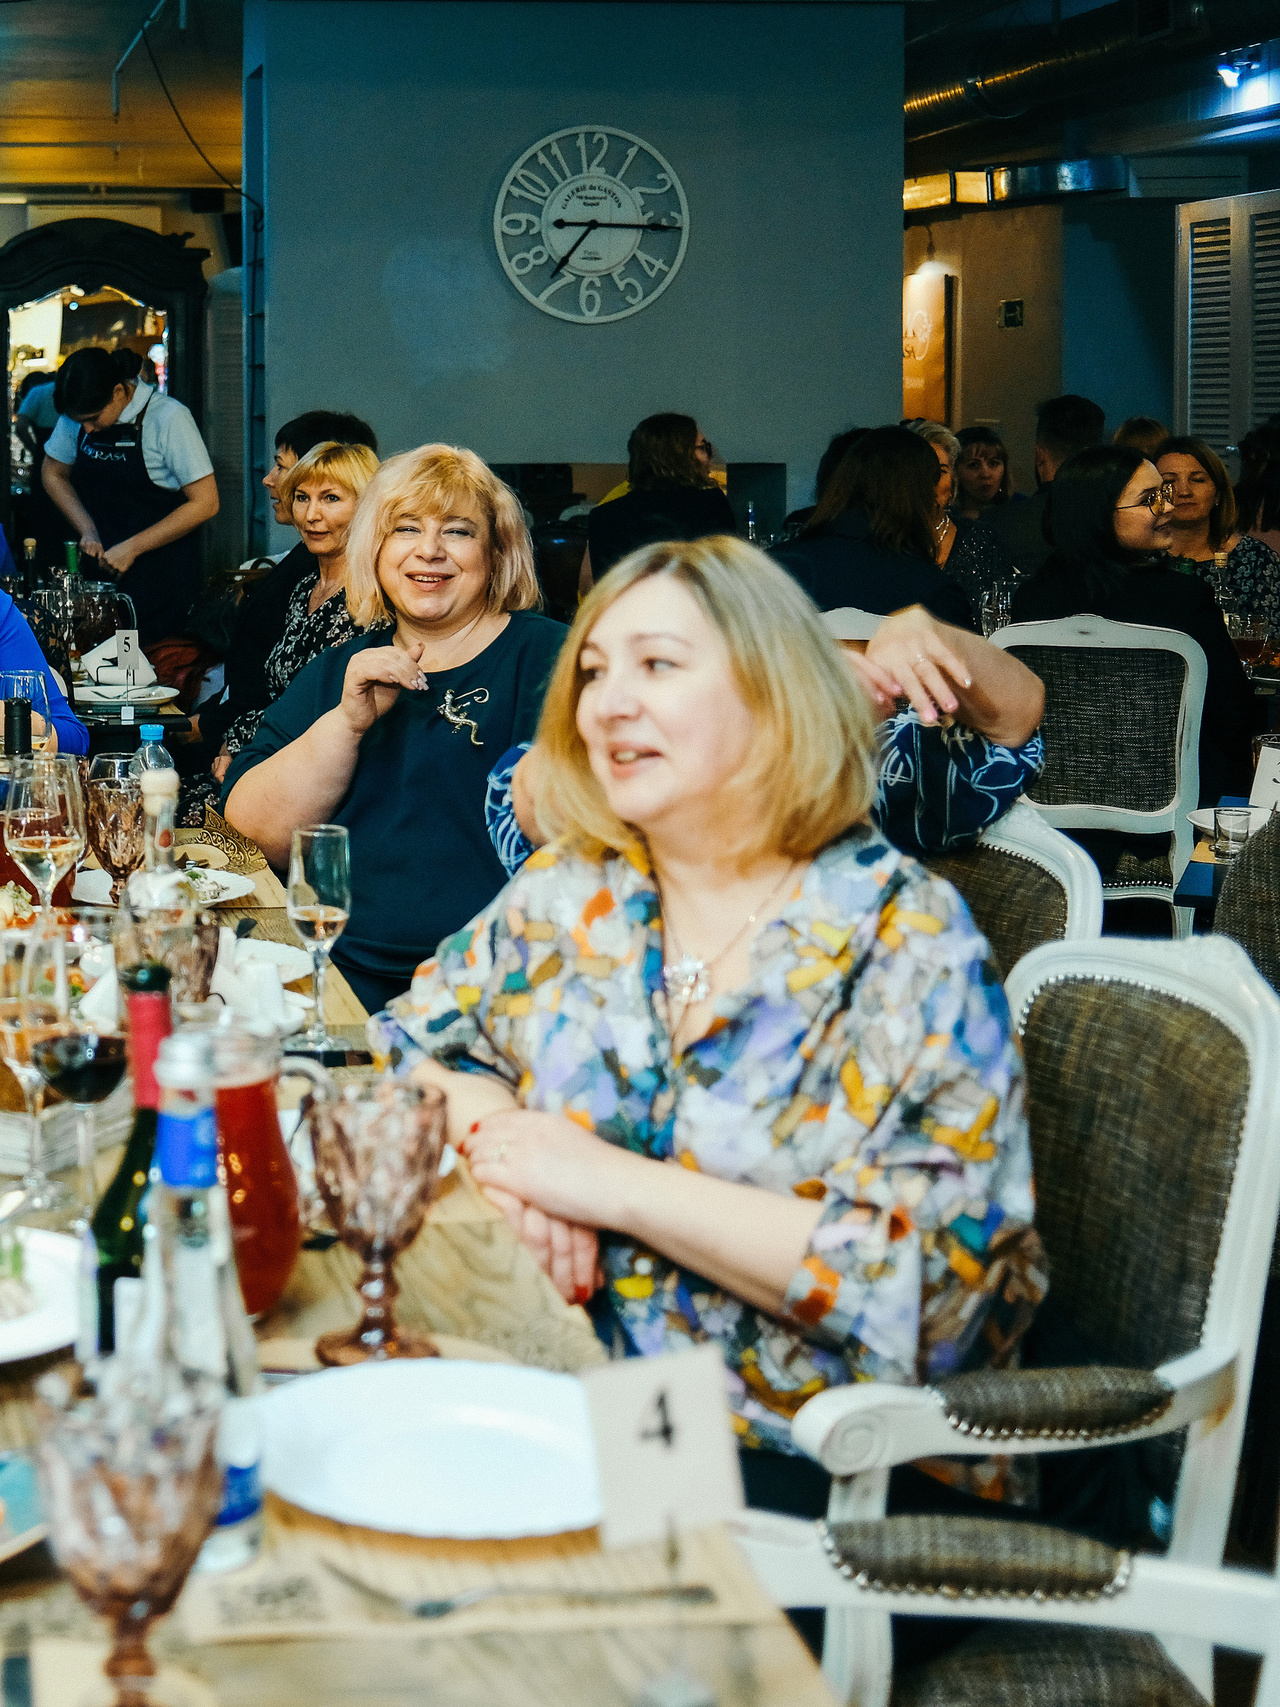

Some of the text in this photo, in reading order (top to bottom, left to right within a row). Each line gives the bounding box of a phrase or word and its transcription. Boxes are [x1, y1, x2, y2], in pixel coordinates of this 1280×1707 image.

[536, 141, 573, 184] 11
[576, 132, 609, 174] 12
[617, 144, 640, 179] 1
[508, 169, 551, 206] 10
[632, 173, 673, 206] 2
[501, 212, 541, 236] 9
[511, 245, 550, 276] 8
[635, 247, 670, 279] 4
[537, 268, 577, 302] 7
[578, 277, 602, 318] 6
[611, 264, 644, 306] 5
[123, 636, 131, 653] 5
